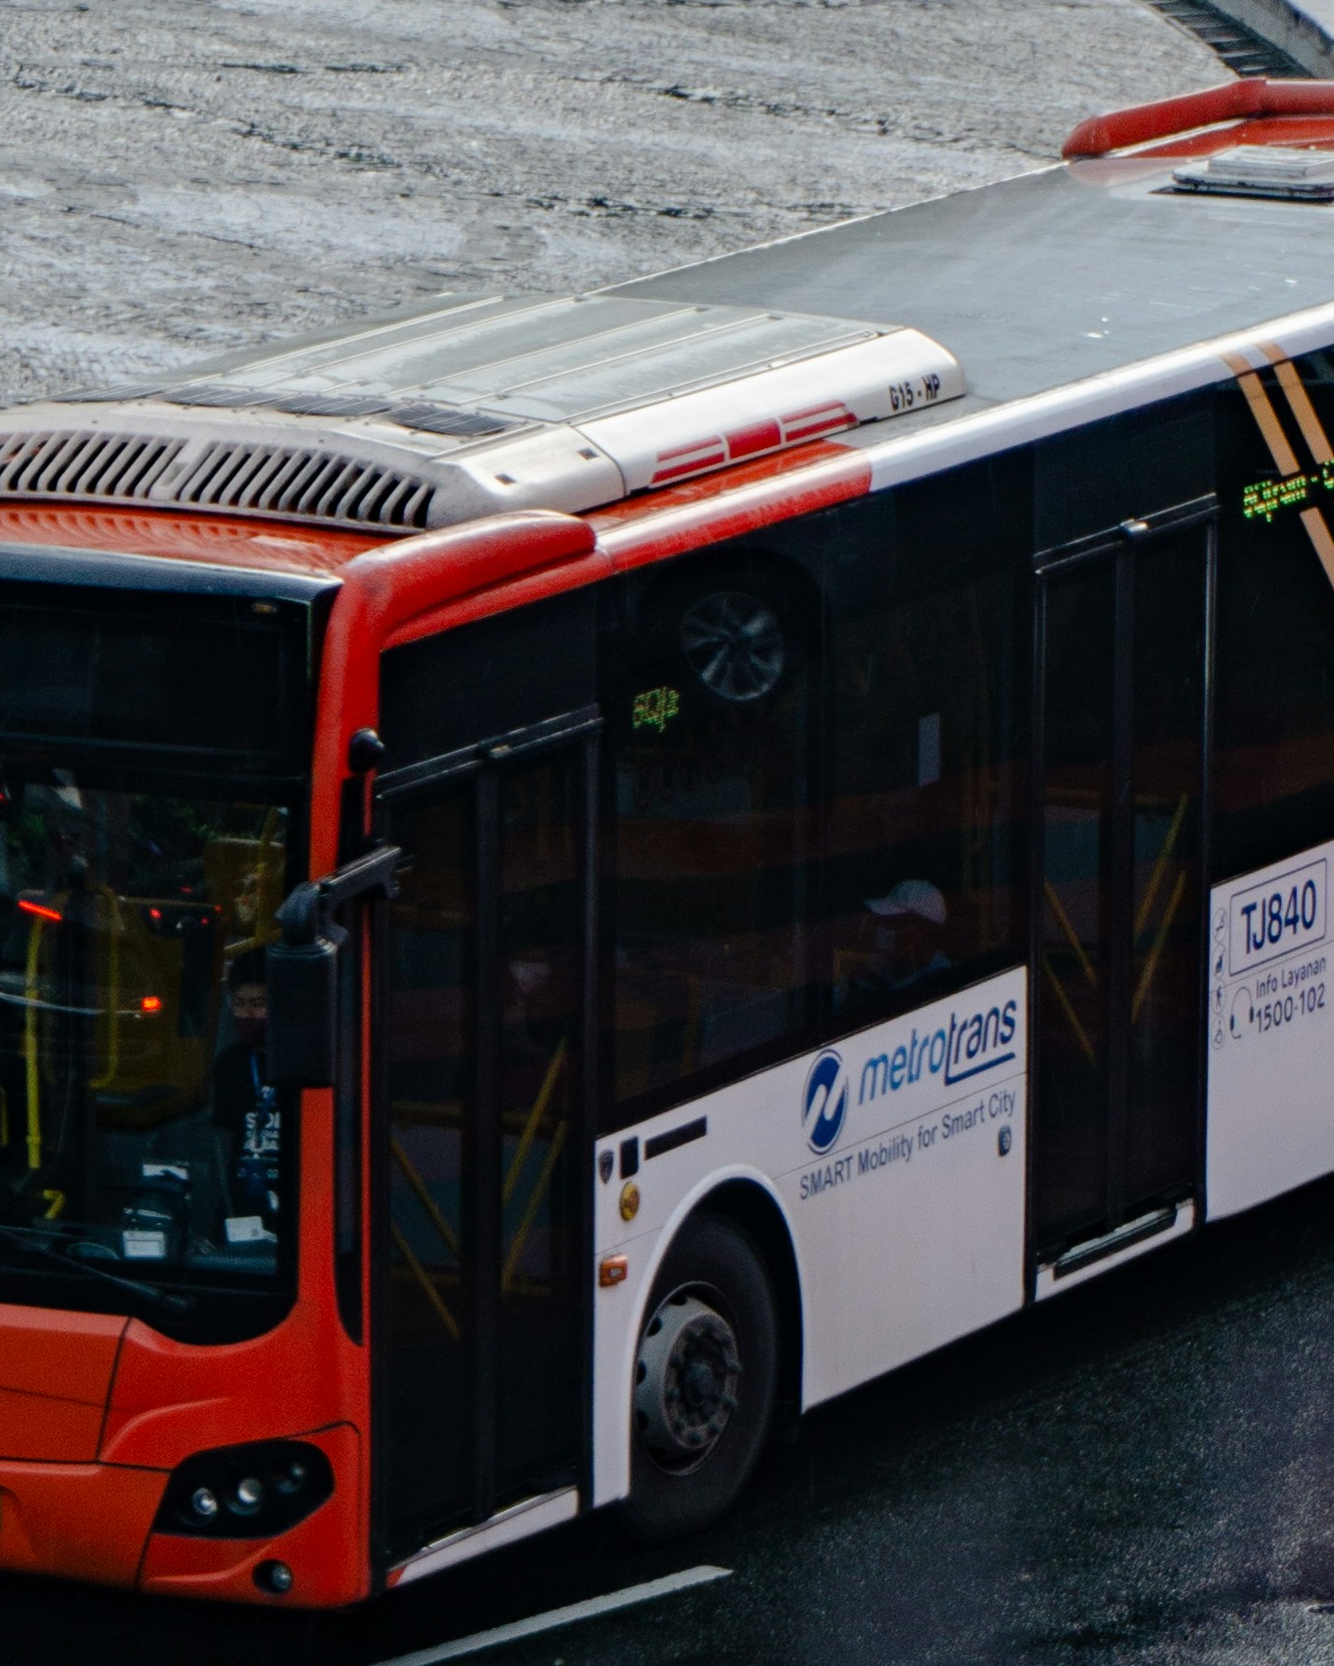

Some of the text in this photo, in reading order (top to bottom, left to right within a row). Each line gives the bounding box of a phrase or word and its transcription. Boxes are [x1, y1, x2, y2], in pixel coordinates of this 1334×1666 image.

[1241, 879, 1317, 955] TJ840
[1256, 957, 1327, 1000] Info Layanan
[1256, 983, 1326, 1034] 1500-102
[858, 999, 1017, 1106] metrotrans
[799, 1089, 1017, 1201] SMART Mobility for Smart City
